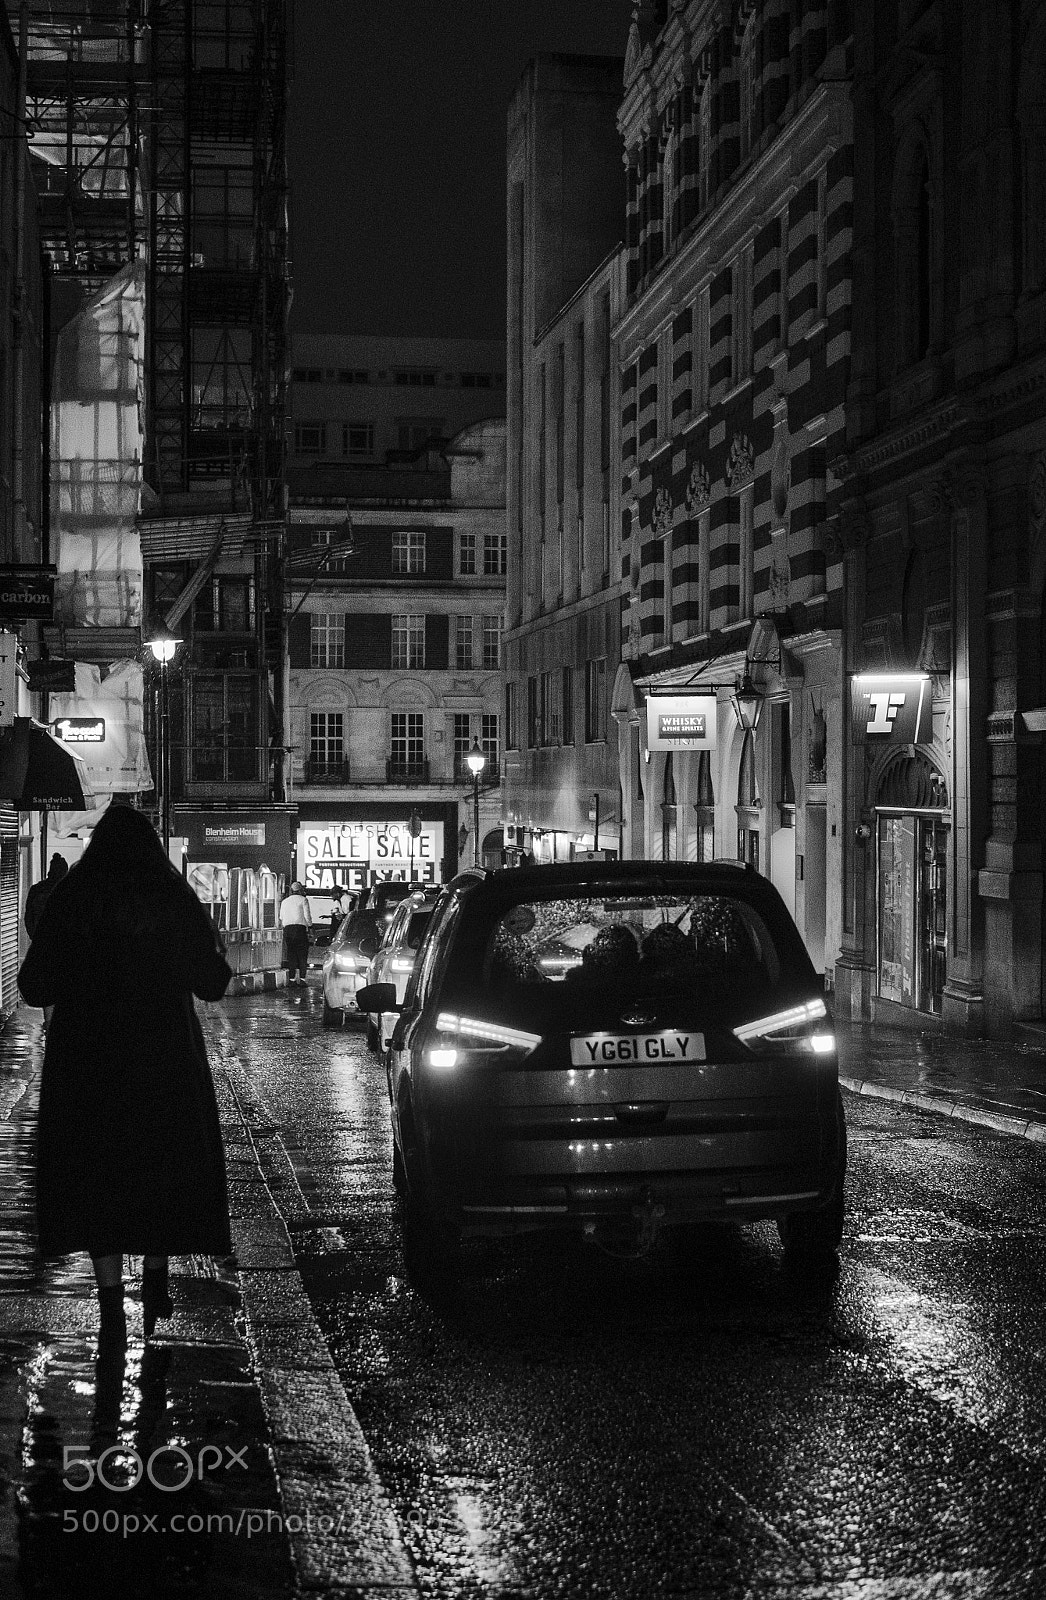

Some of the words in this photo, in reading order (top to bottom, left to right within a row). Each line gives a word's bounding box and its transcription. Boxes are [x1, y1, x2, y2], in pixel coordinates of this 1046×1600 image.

[1, 590, 51, 604] carbon
[661, 717, 703, 725] WHISKY
[32, 796, 73, 804] Sandwich
[205, 827, 239, 836] Blenheim
[307, 835, 361, 858] SALE
[376, 834, 430, 858] SALE
[306, 864, 363, 890] SALE
[585, 1038, 639, 1061] YG61
[645, 1036, 690, 1059] GLY
